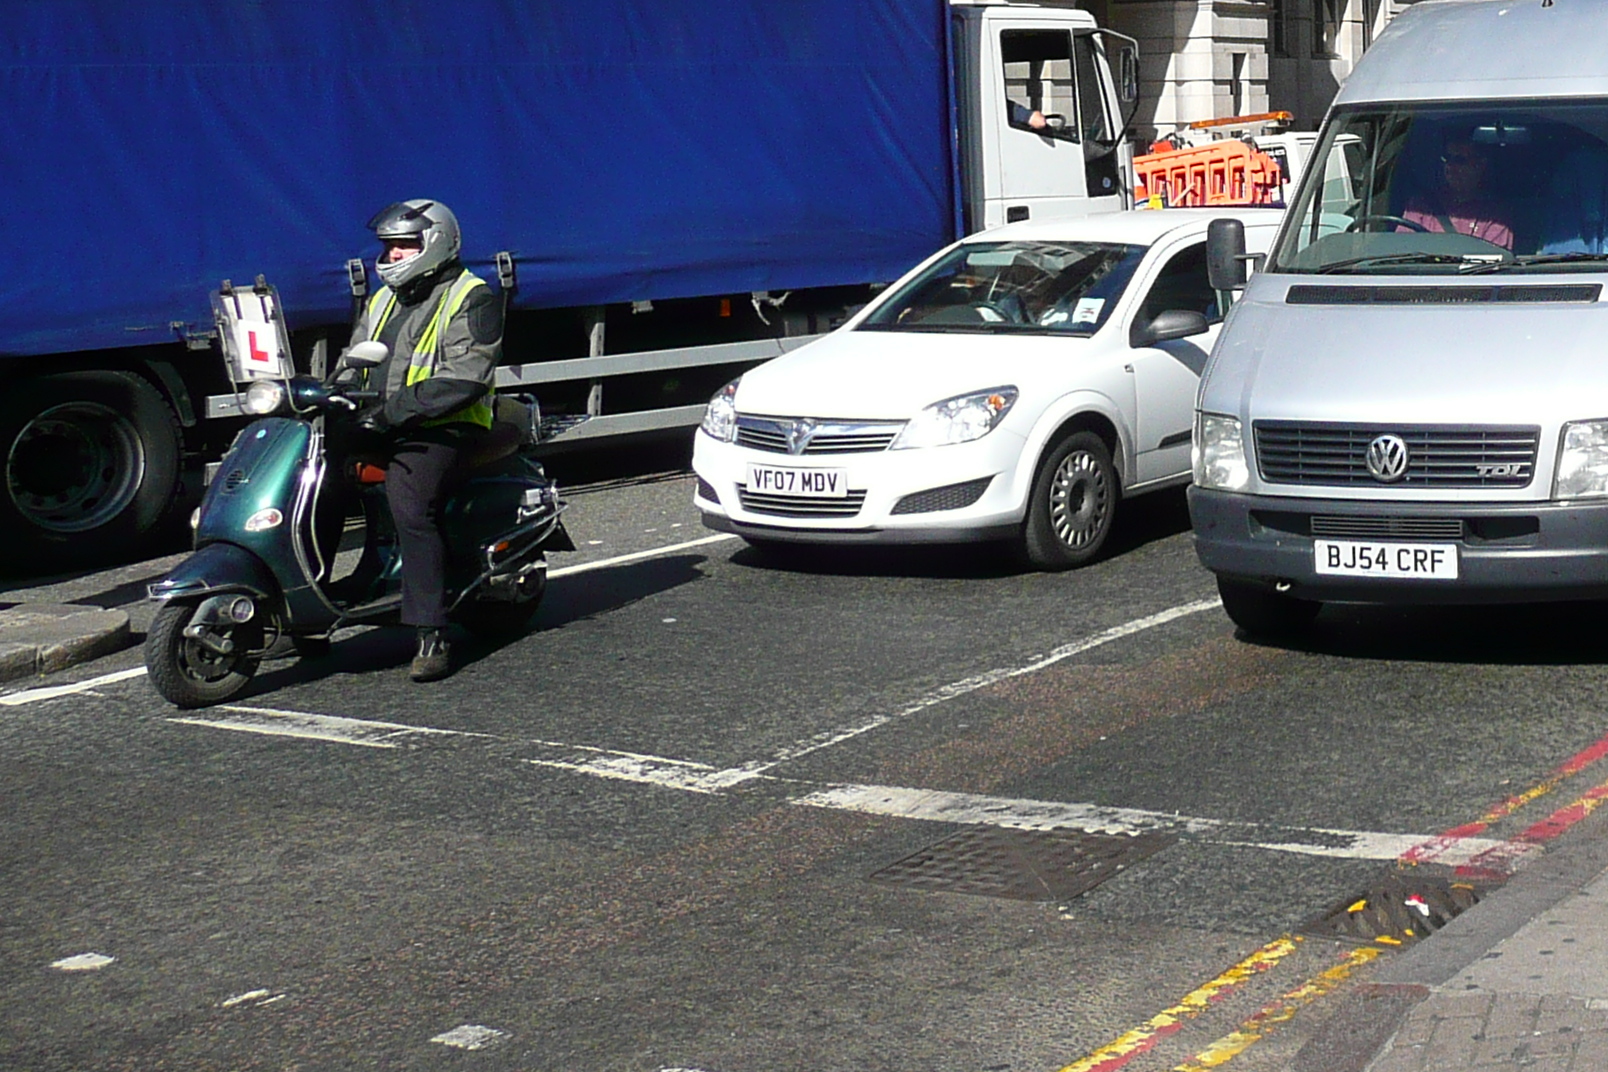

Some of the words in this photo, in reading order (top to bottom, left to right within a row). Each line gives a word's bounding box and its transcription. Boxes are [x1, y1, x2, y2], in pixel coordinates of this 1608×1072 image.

[248, 330, 269, 362] L
[753, 468, 796, 491] VF07
[801, 472, 838, 493] MDV
[1476, 464, 1522, 478] TDI
[1327, 545, 1389, 571] BJ54
[1396, 548, 1445, 573] CRF
